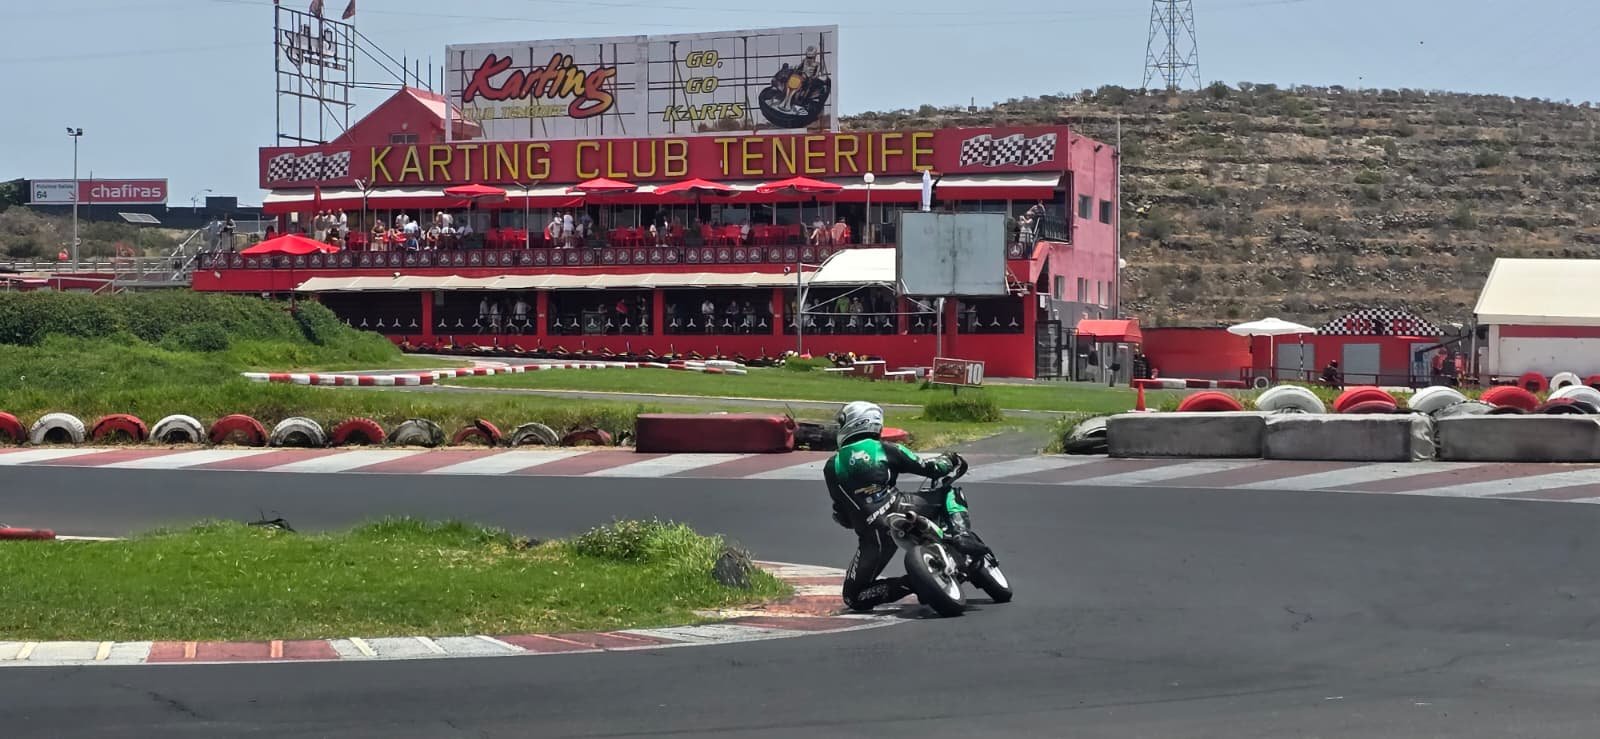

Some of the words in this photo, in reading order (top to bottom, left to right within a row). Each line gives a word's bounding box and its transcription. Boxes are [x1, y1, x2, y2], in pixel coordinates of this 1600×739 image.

[463, 52, 617, 120] Karting
[685, 75, 719, 94] GO
[662, 102, 747, 122] KARTS
[370, 143, 551, 182] KARTING
[575, 139, 689, 179] CLUB
[714, 131, 935, 176] TENERIFE
[36, 190, 48, 199] 64
[91, 184, 161, 198] chafiras
[966, 362, 984, 385] 10
